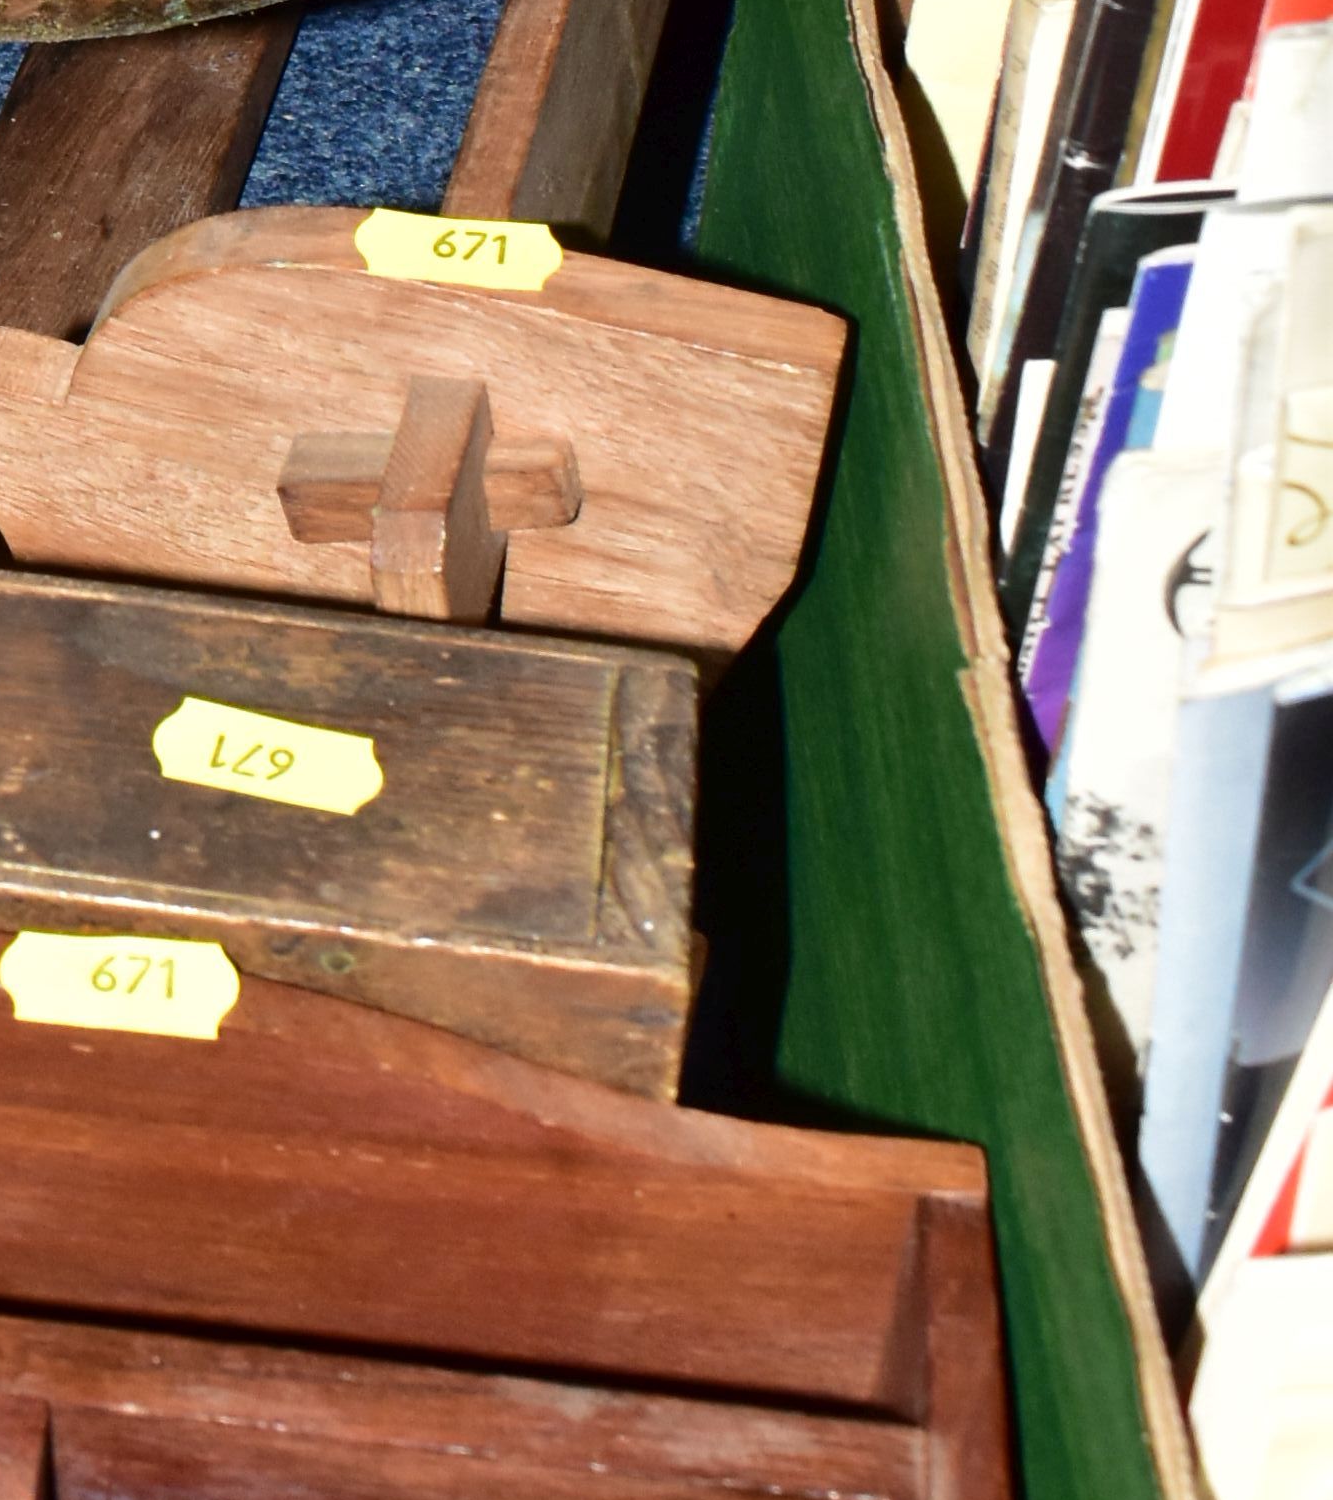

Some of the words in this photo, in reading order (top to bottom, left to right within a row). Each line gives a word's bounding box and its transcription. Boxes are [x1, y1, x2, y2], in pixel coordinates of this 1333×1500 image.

[432, 227, 510, 266] 671
[207, 733, 297, 780] 671
[90, 956, 176, 1001] 671
